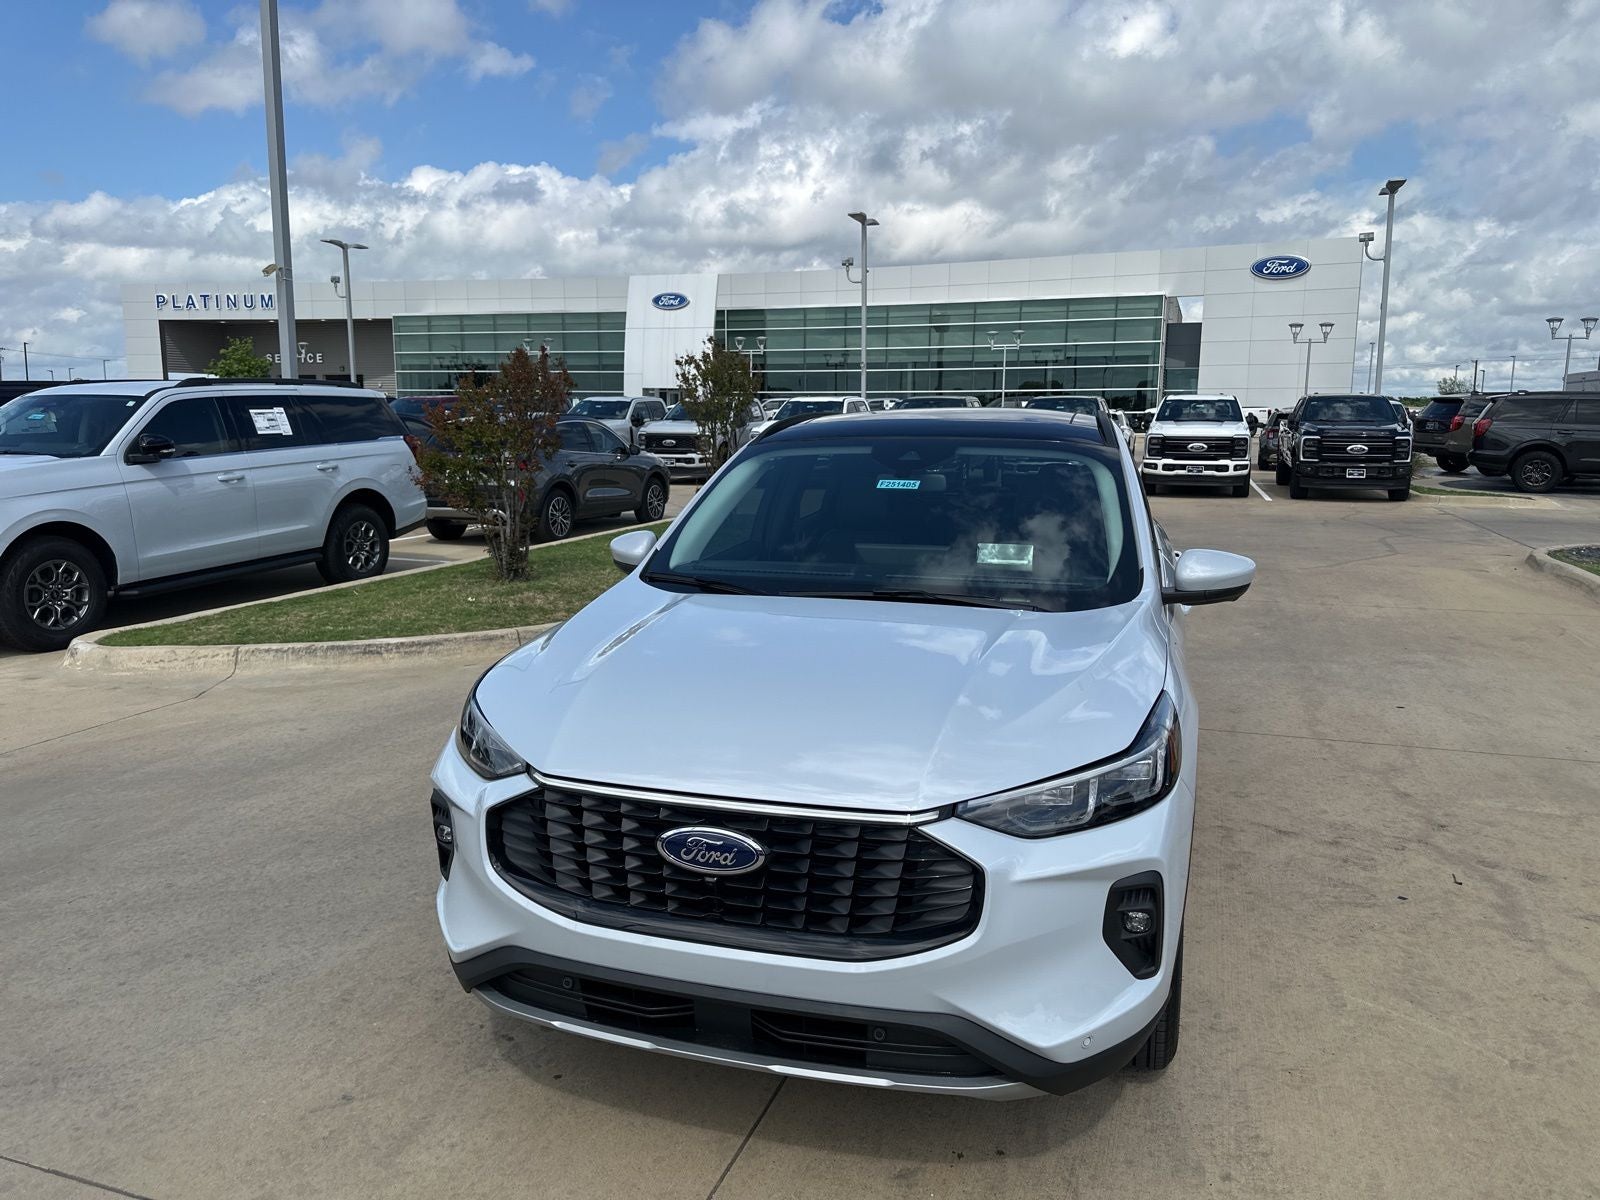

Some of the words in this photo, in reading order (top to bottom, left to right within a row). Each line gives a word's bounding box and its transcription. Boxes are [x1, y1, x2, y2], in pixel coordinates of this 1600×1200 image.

[1262, 259, 1298, 274] Ford
[155, 294, 274, 310] PLATINUM
[658, 295, 680, 306] Ford
[266, 353, 323, 363] SEICE
[680, 836, 738, 866] Ford
